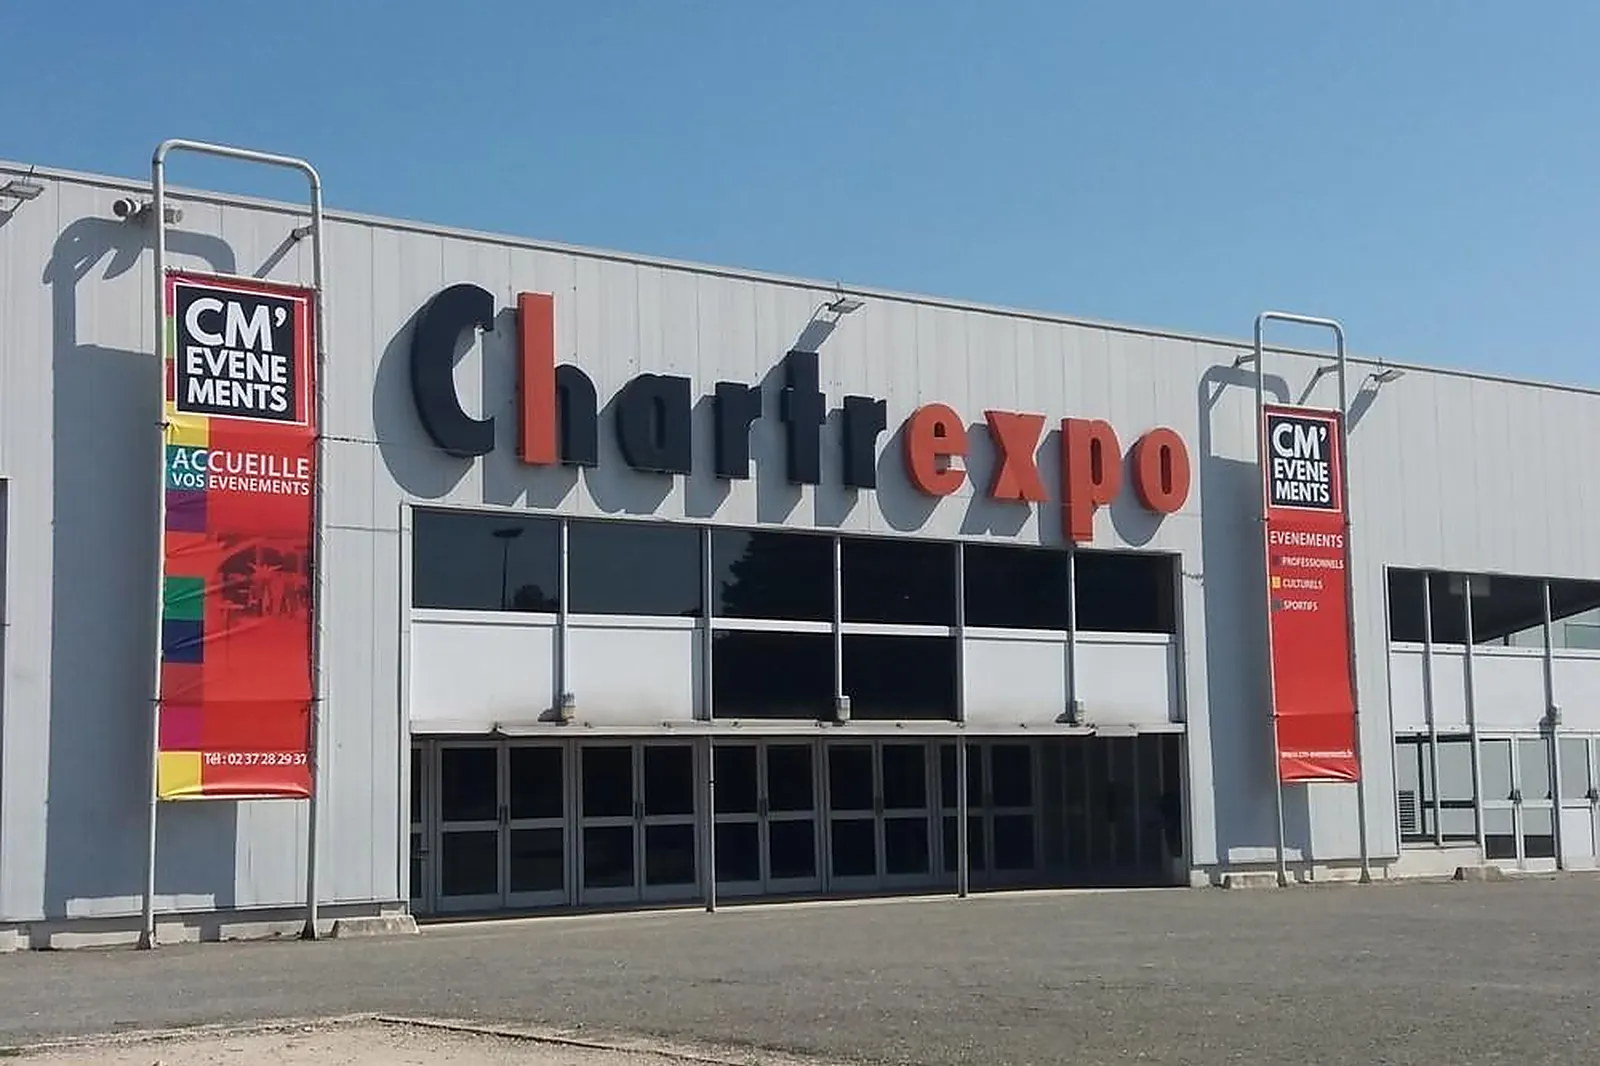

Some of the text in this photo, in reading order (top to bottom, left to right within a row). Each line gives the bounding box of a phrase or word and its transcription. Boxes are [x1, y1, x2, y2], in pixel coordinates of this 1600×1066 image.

[186, 346, 287, 384] EVENE
[187, 377, 288, 412] MENTS
[411, 283, 1191, 543] Chartrexpo
[172, 448, 309, 479] ACCUEILLE
[1274, 459, 1329, 482] EVENE
[172, 473, 309, 496] VOS EVENEMENTS
[1276, 480, 1330, 503] MENTS
[1270, 530, 1344, 548] EVENEMENTS
[227, 753, 243, 765] 02
[244, 753, 260, 765] 37
